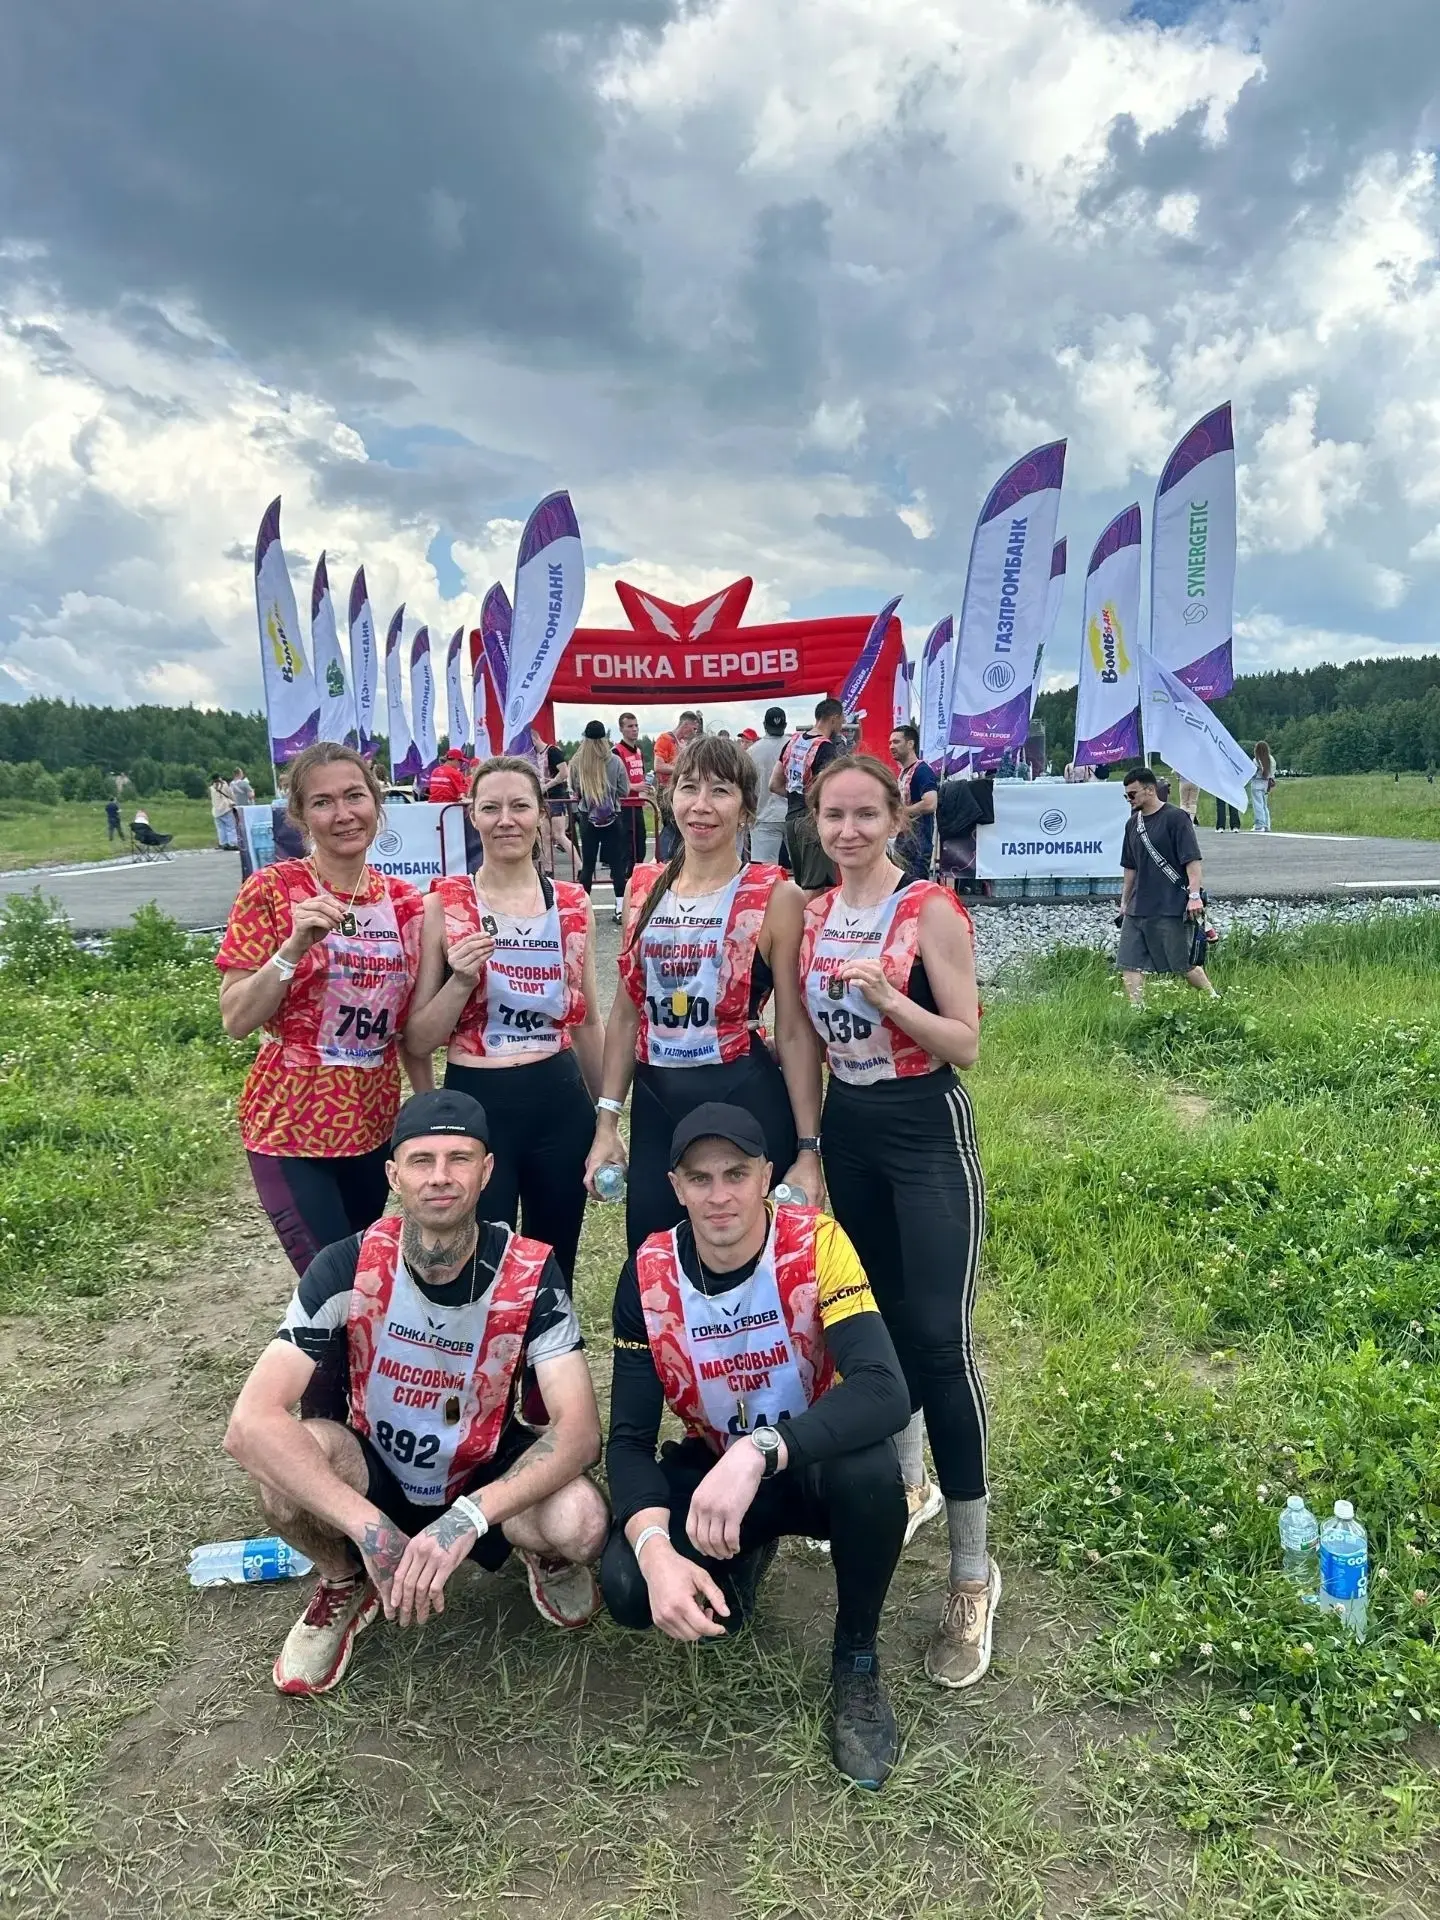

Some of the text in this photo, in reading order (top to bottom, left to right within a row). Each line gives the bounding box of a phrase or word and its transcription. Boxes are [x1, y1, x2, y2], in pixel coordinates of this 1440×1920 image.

[1187, 500, 1208, 597] SYNERGETIC
[994, 517, 1028, 653] ГАЗПРОМБАНК
[521, 562, 563, 689] ГАЗПРОМБАНК
[575, 648, 799, 679] ГОНКА ГЕРОЕВ
[1001, 840, 1103, 856] ГАЗПРОМБАНК
[368, 861, 441, 875] РОМБАНК
[650, 916, 723, 925] ГОНКА ГЕРОЕВ
[523, 939, 559, 948] ГЕРОЕВ
[823, 929, 882, 940] ГОНКА ГЕРОЕВ
[334, 950, 403, 972] МАССОВЫЙ
[644, 940, 718, 959] МАССОВЫЙ
[352, 972, 386, 988] СТАРТ
[489, 960, 562, 980] МАССОВЫЙ
[509, 980, 545, 995] СТАРТ
[335, 1005, 389, 1040] 764
[664, 1045, 715, 1058] ГАЗПРОМБАНК
[692, 1309, 779, 1338] ГОНКА ГЕРОЕВ
[388, 1322, 474, 1352] ГОНКА ГЕРОЕВ
[699, 1341, 789, 1381] МАССОВЫЙ
[377, 1357, 467, 1391] МАССОВЫЙ
[728, 1371, 772, 1393] СТАРТ
[393, 1386, 441, 1410] СТАРТ
[376, 1420, 441, 1469] 892
[1357, 1566, 1367, 1597] ION
